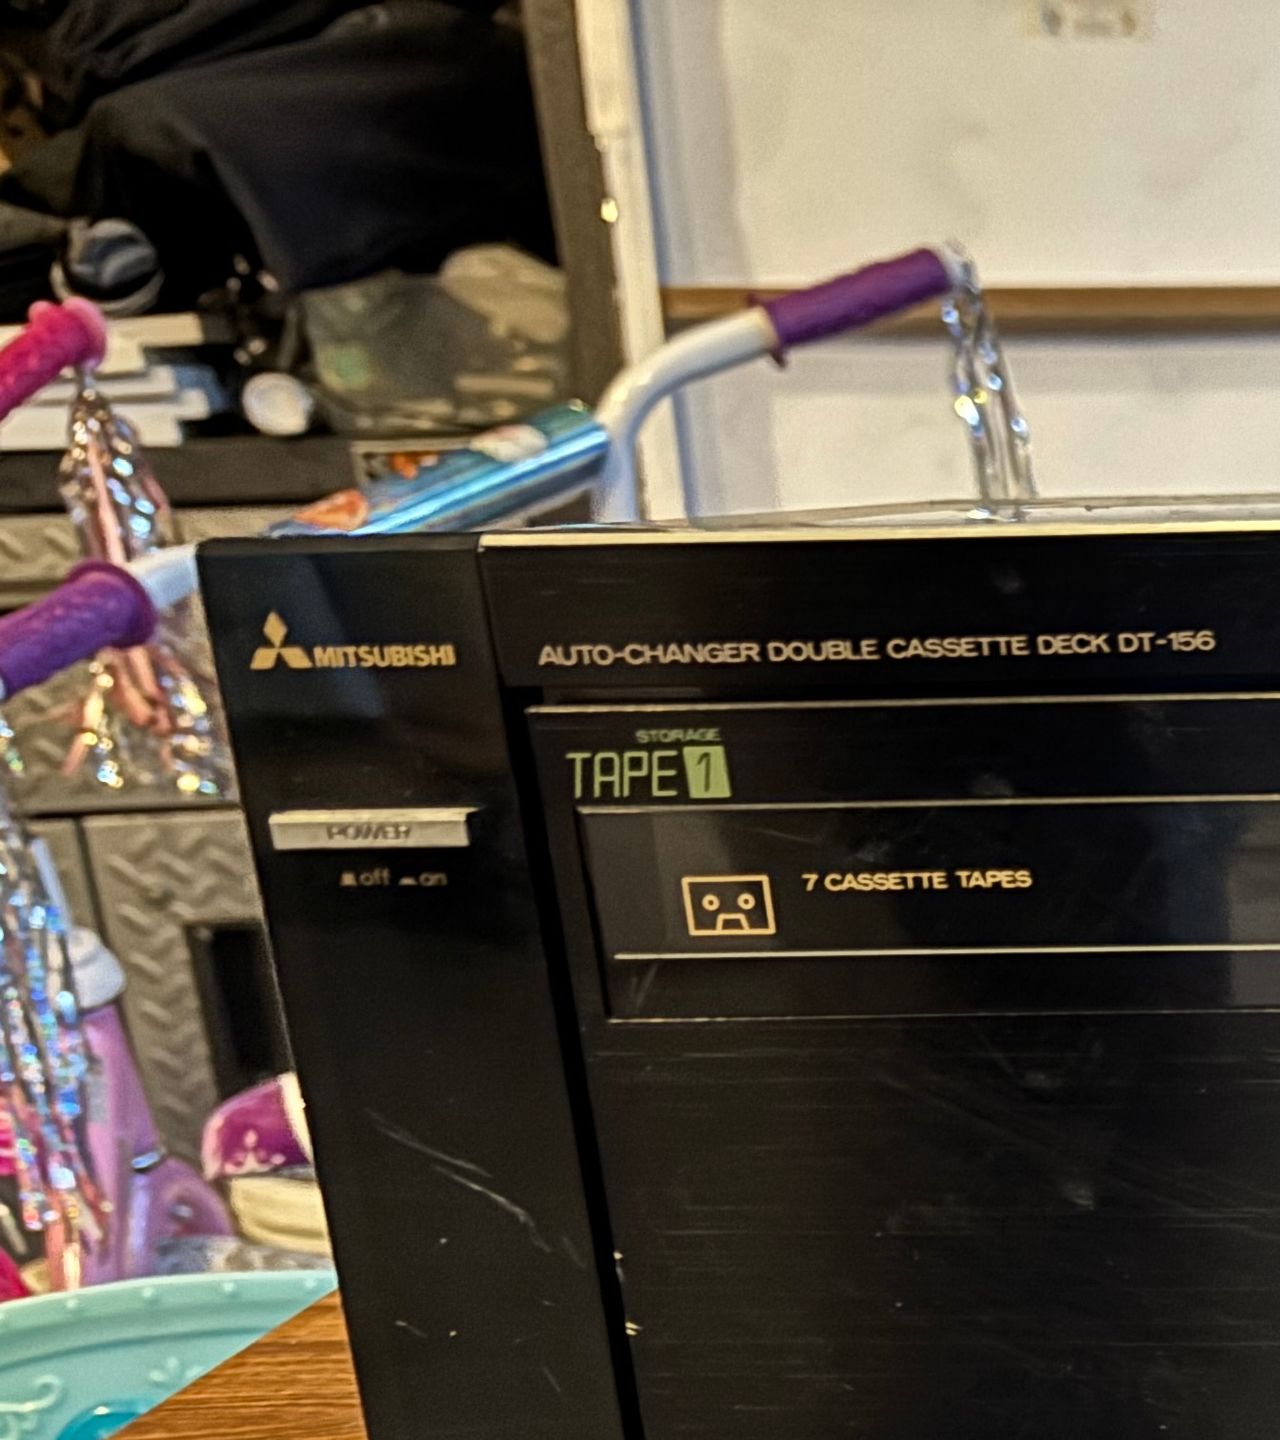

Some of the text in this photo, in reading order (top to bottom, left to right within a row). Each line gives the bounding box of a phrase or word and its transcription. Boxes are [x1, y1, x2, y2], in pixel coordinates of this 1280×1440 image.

[314, 645, 456, 668] MITSUBISHI
[539, 630, 1216, 666] AUTO-CHANGER DOUBLE CASSETTE DECK DT-156
[635, 728, 722, 743] STORAGE
[565, 751, 678, 798] TAPE
[326, 825, 412, 841] POWER
[360, 868, 391, 886] off
[419, 872, 448, 886] on
[802, 870, 1033, 892] 7 CASSETTE TAPES
